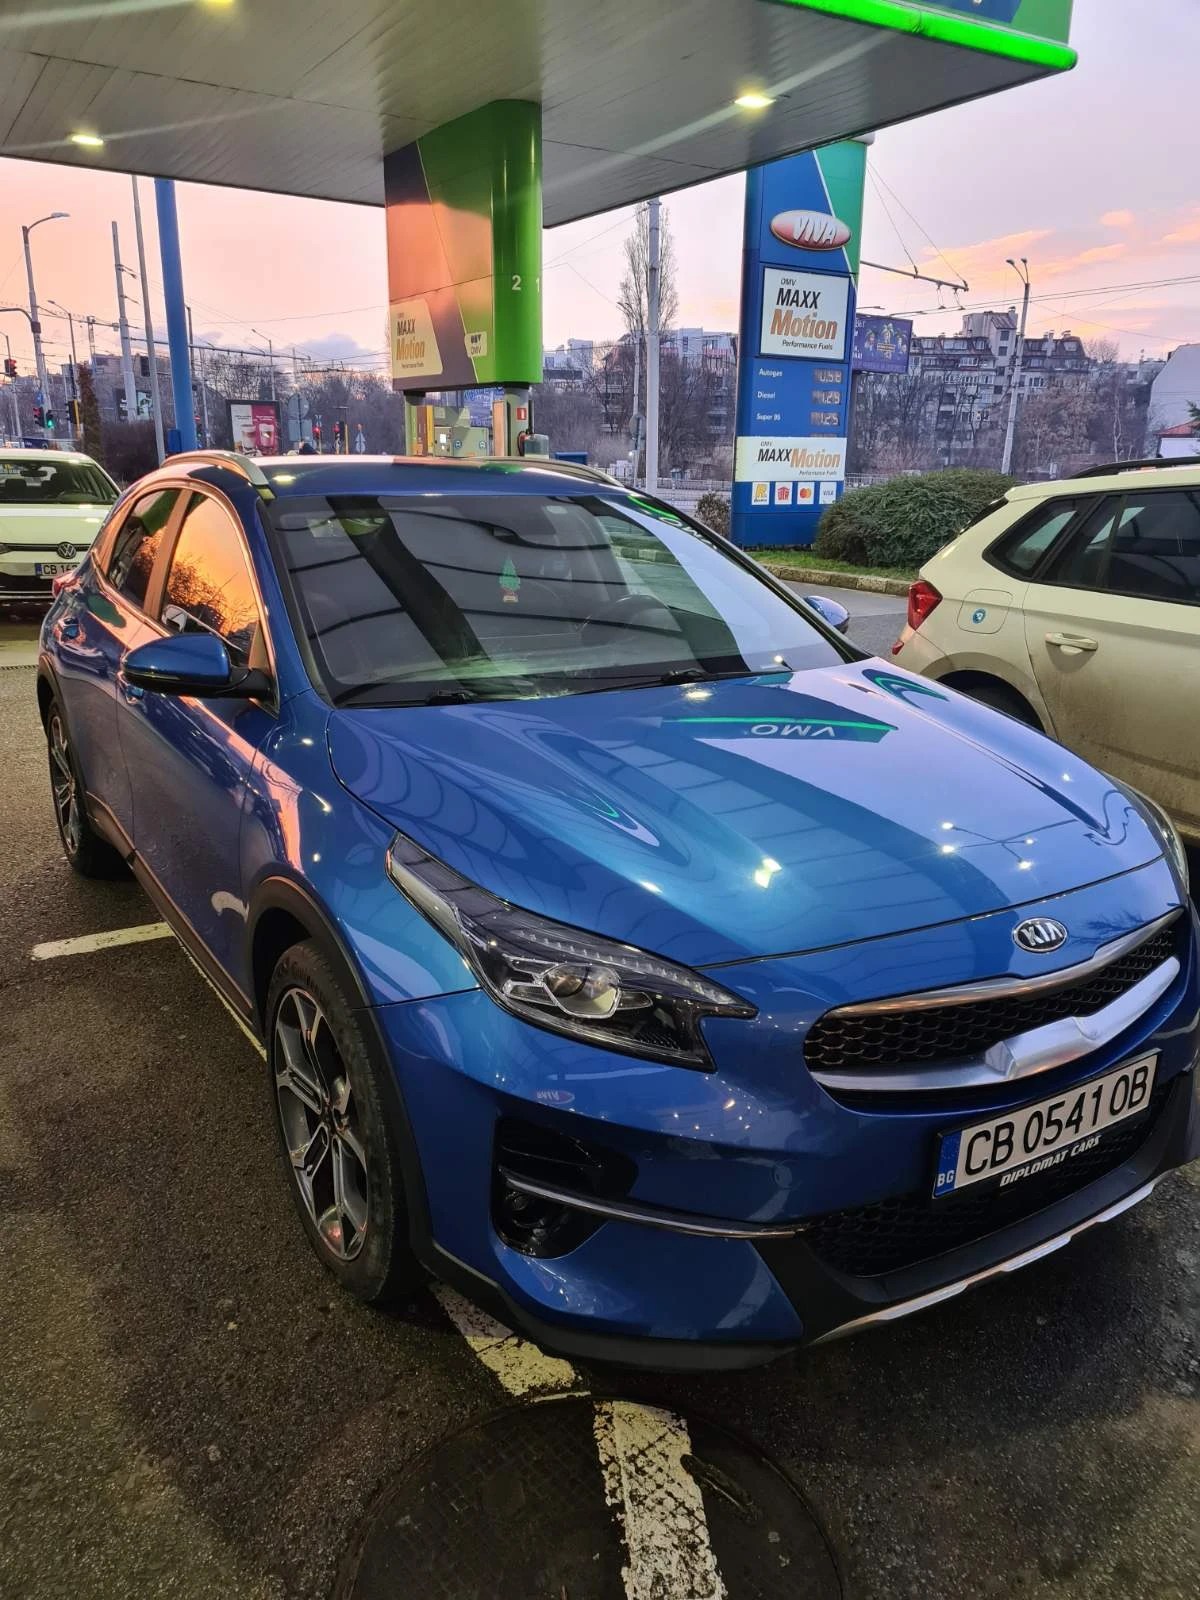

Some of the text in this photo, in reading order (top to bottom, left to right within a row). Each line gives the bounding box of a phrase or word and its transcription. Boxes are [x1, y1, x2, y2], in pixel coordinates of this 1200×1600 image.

[793, 215, 838, 244] VIVA
[511, 274, 522, 291] 2
[780, 278, 796, 286] OMV
[776, 287, 821, 309] MAXX
[397, 319, 415, 336] MAXX
[770, 308, 838, 340] Motion
[782, 340, 833, 350] Performance Fuels
[759, 367, 783, 378] Autogas
[757, 390, 776, 400] Diesel
[43, 564, 58, 575] CB
[1020, 921, 1063, 946] KIA
[964, 1120, 1015, 1176] CB
[1023, 1084, 1103, 1154] 0541
[1000, 1134, 1104, 1188] DIPLOMAT CARS
[936, 1169, 955, 1188] BG
